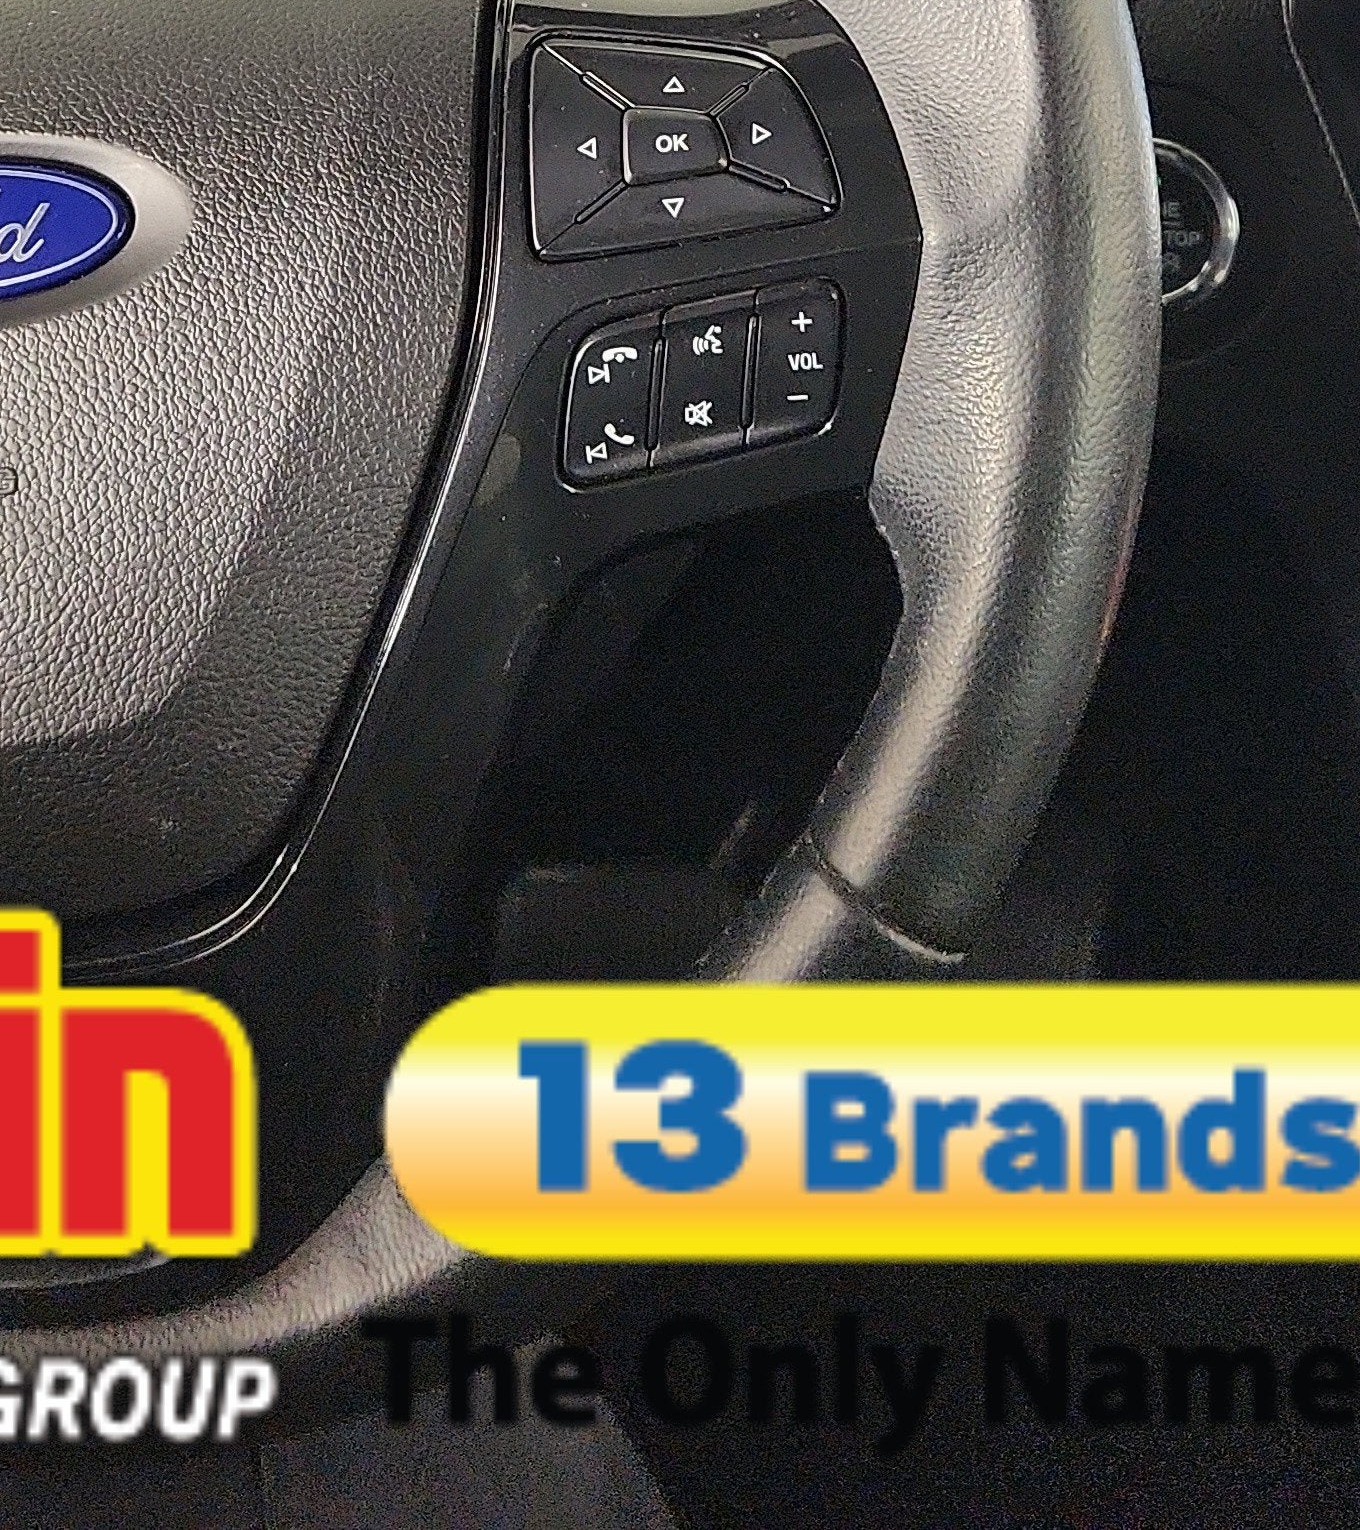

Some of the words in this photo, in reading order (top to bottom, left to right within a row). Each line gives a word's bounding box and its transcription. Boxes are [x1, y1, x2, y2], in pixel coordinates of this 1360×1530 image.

[655, 133, 689, 154] OK
[1162, 230, 1200, 246] TOP
[788, 352, 823, 371] VOL
